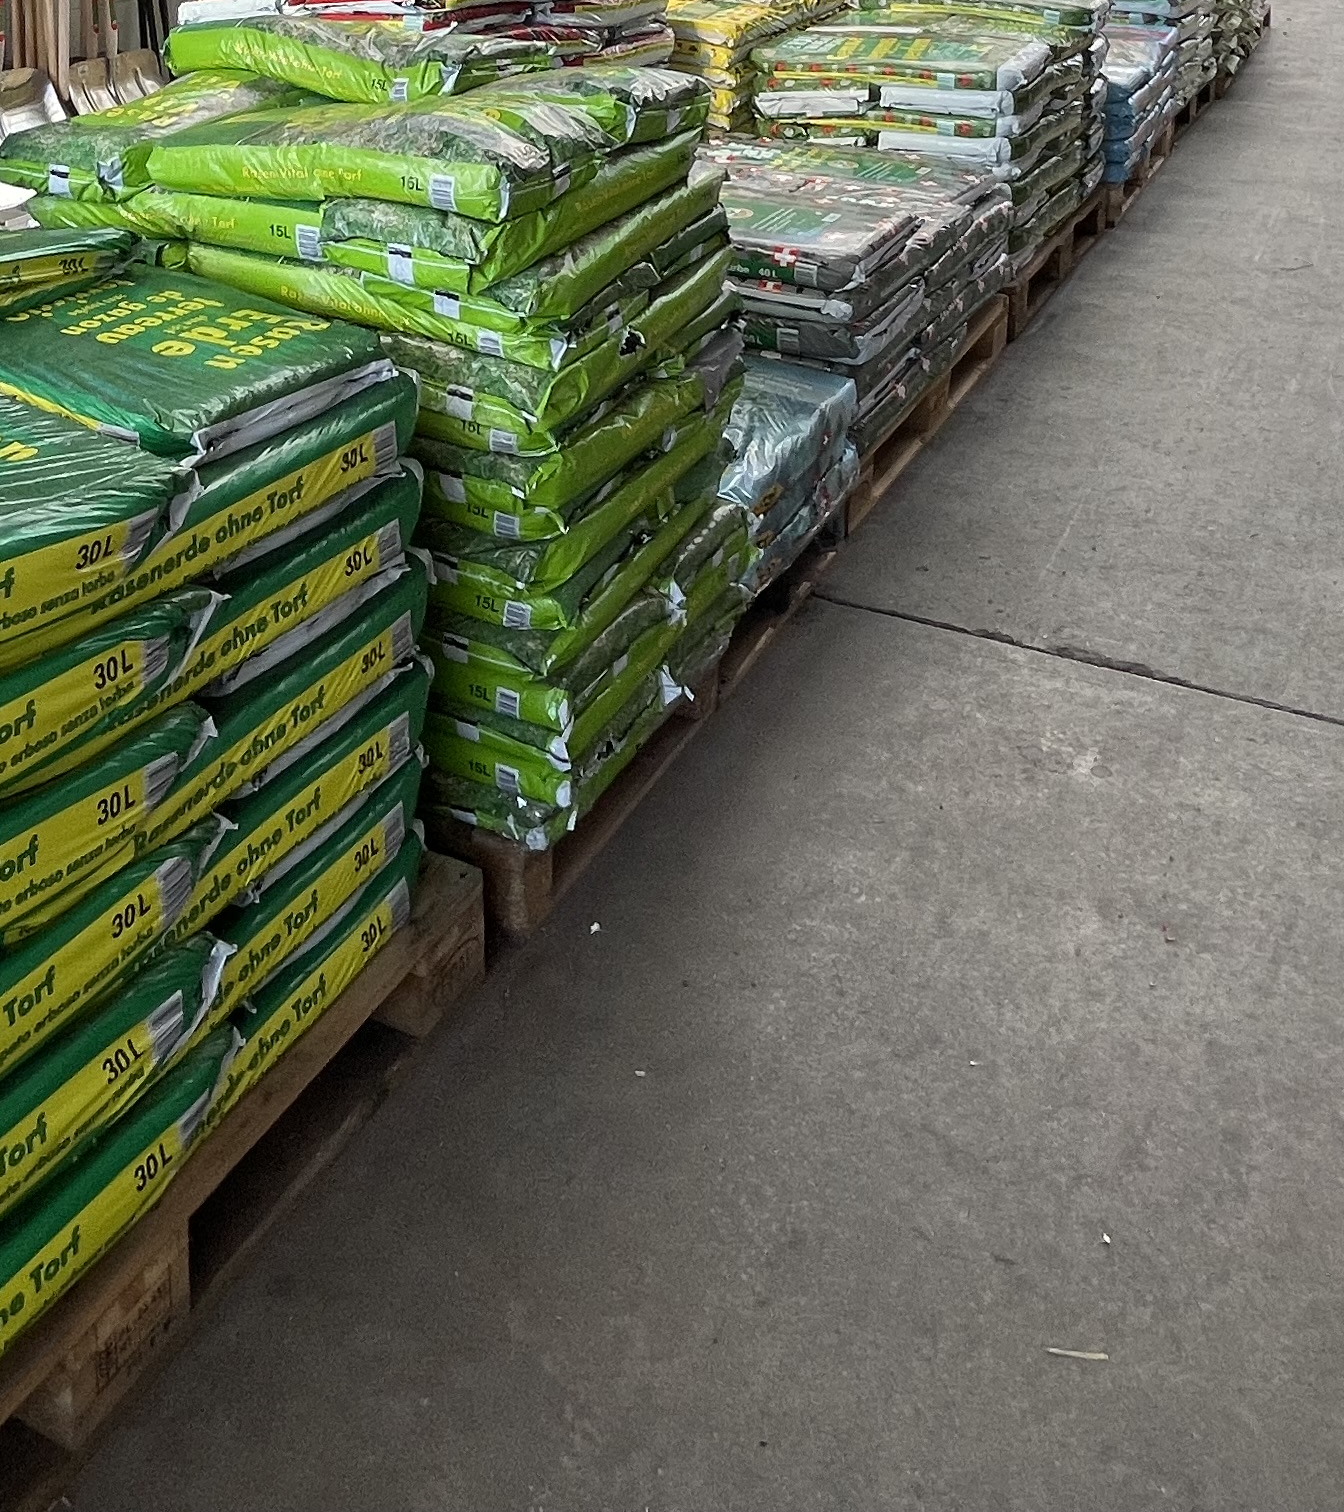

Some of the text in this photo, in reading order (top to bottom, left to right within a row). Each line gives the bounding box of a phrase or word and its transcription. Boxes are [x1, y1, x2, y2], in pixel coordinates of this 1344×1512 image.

[269, 224, 291, 239] 15L
[151, 308, 282, 357] Erde
[215, 506, 263, 545] ohne
[265, 475, 305, 512] Torf
[40, 587, 80, 615] senza
[220, 616, 268, 659] ohne
[271, 583, 309, 626] Torf
[476, 595, 499, 612] 15L
[290, 685, 327, 726] Torf
[469, 684, 492, 702] 15L
[10, 731, 58, 774] erboso
[61, 708, 99, 742] senza
[469, 760, 491, 777] 15L
[235, 825, 283, 878] ohne
[285, 787, 322, 831] Torf
[15, 860, 64, 906] erboso
[283, 889, 319, 939] Torf
[2, 965, 56, 1029] Torf
[290, 973, 328, 1019] Torf
[28, 1225, 81, 1293] Torf
